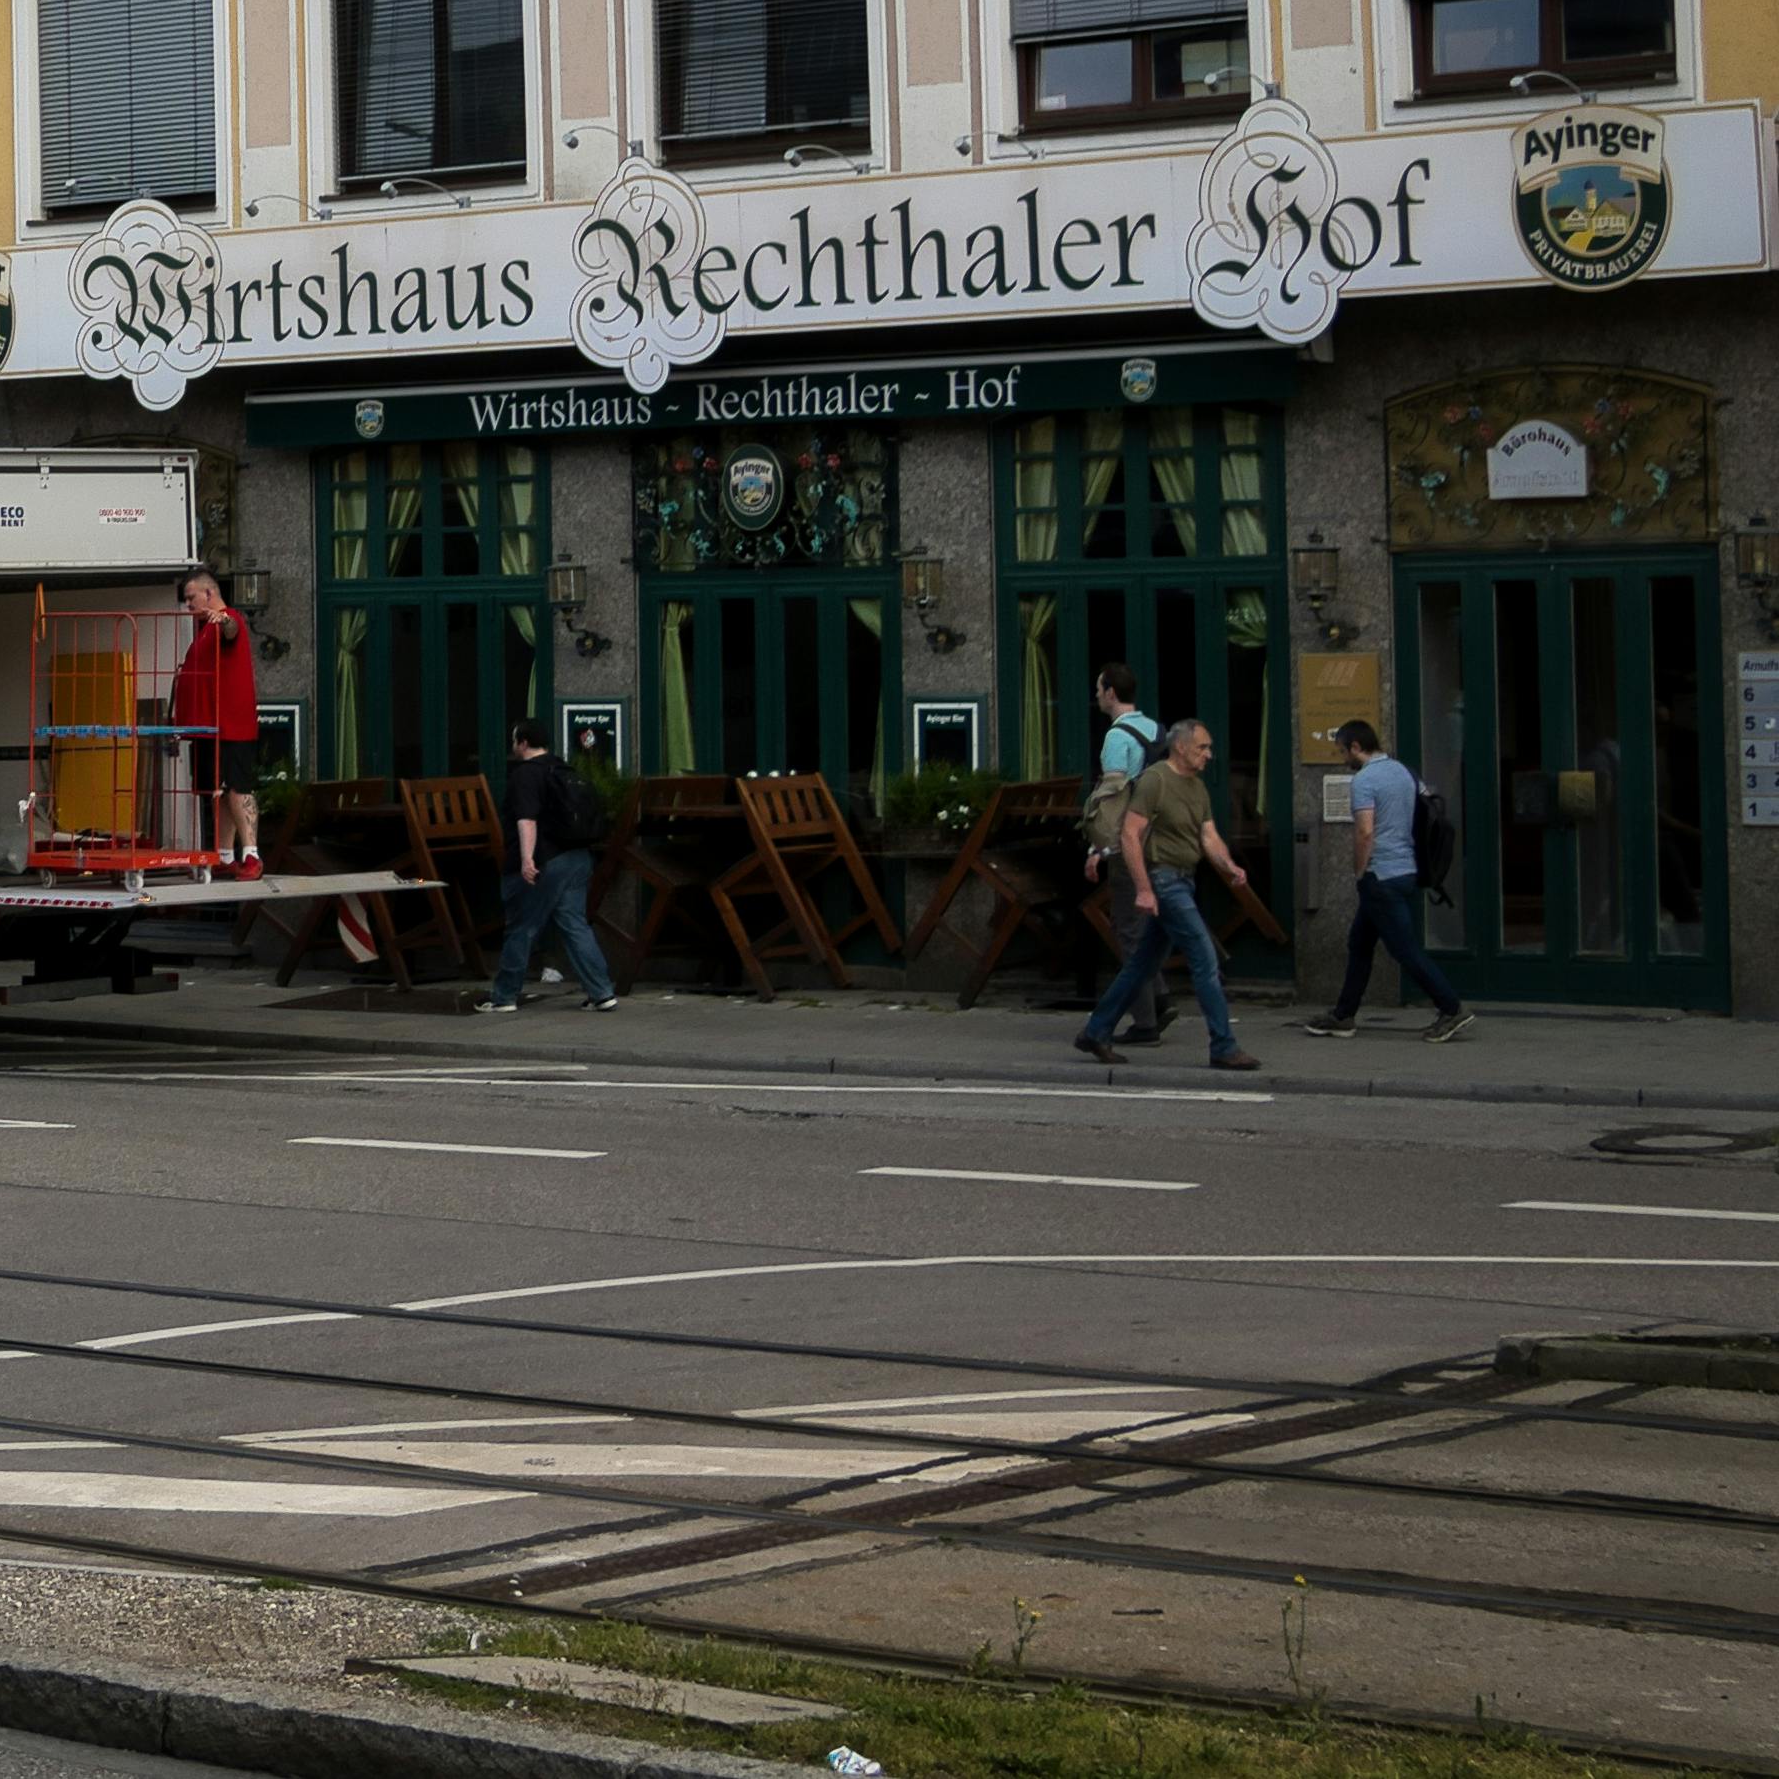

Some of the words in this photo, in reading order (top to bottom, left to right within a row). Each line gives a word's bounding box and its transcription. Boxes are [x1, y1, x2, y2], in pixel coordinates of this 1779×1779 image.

[1524, 116, 1656, 167] Ayinger
[81, 243, 535, 352] Wirtshaus
[579, 190, 1157, 326] Rechthaler
[1199, 158, 1430, 303] Hof
[1528, 221, 1659, 279] PRIVATBRAUEREI
[469, 392, 651, 433] Wirtshaus
[696, 377, 900, 423] Rechthaler
[946, 366, 1023, 409] Hof
[1501, 426, 1572, 458] Bürohaus
[0, 519, 25, 528] RENT
[1743, 687, 1755, 702] 6
[1744, 715, 1756, 731] 5
[1745, 744, 1757, 759] 4
[1746, 773, 1758, 789] 3
[1748, 802, 1758, 817] 1
